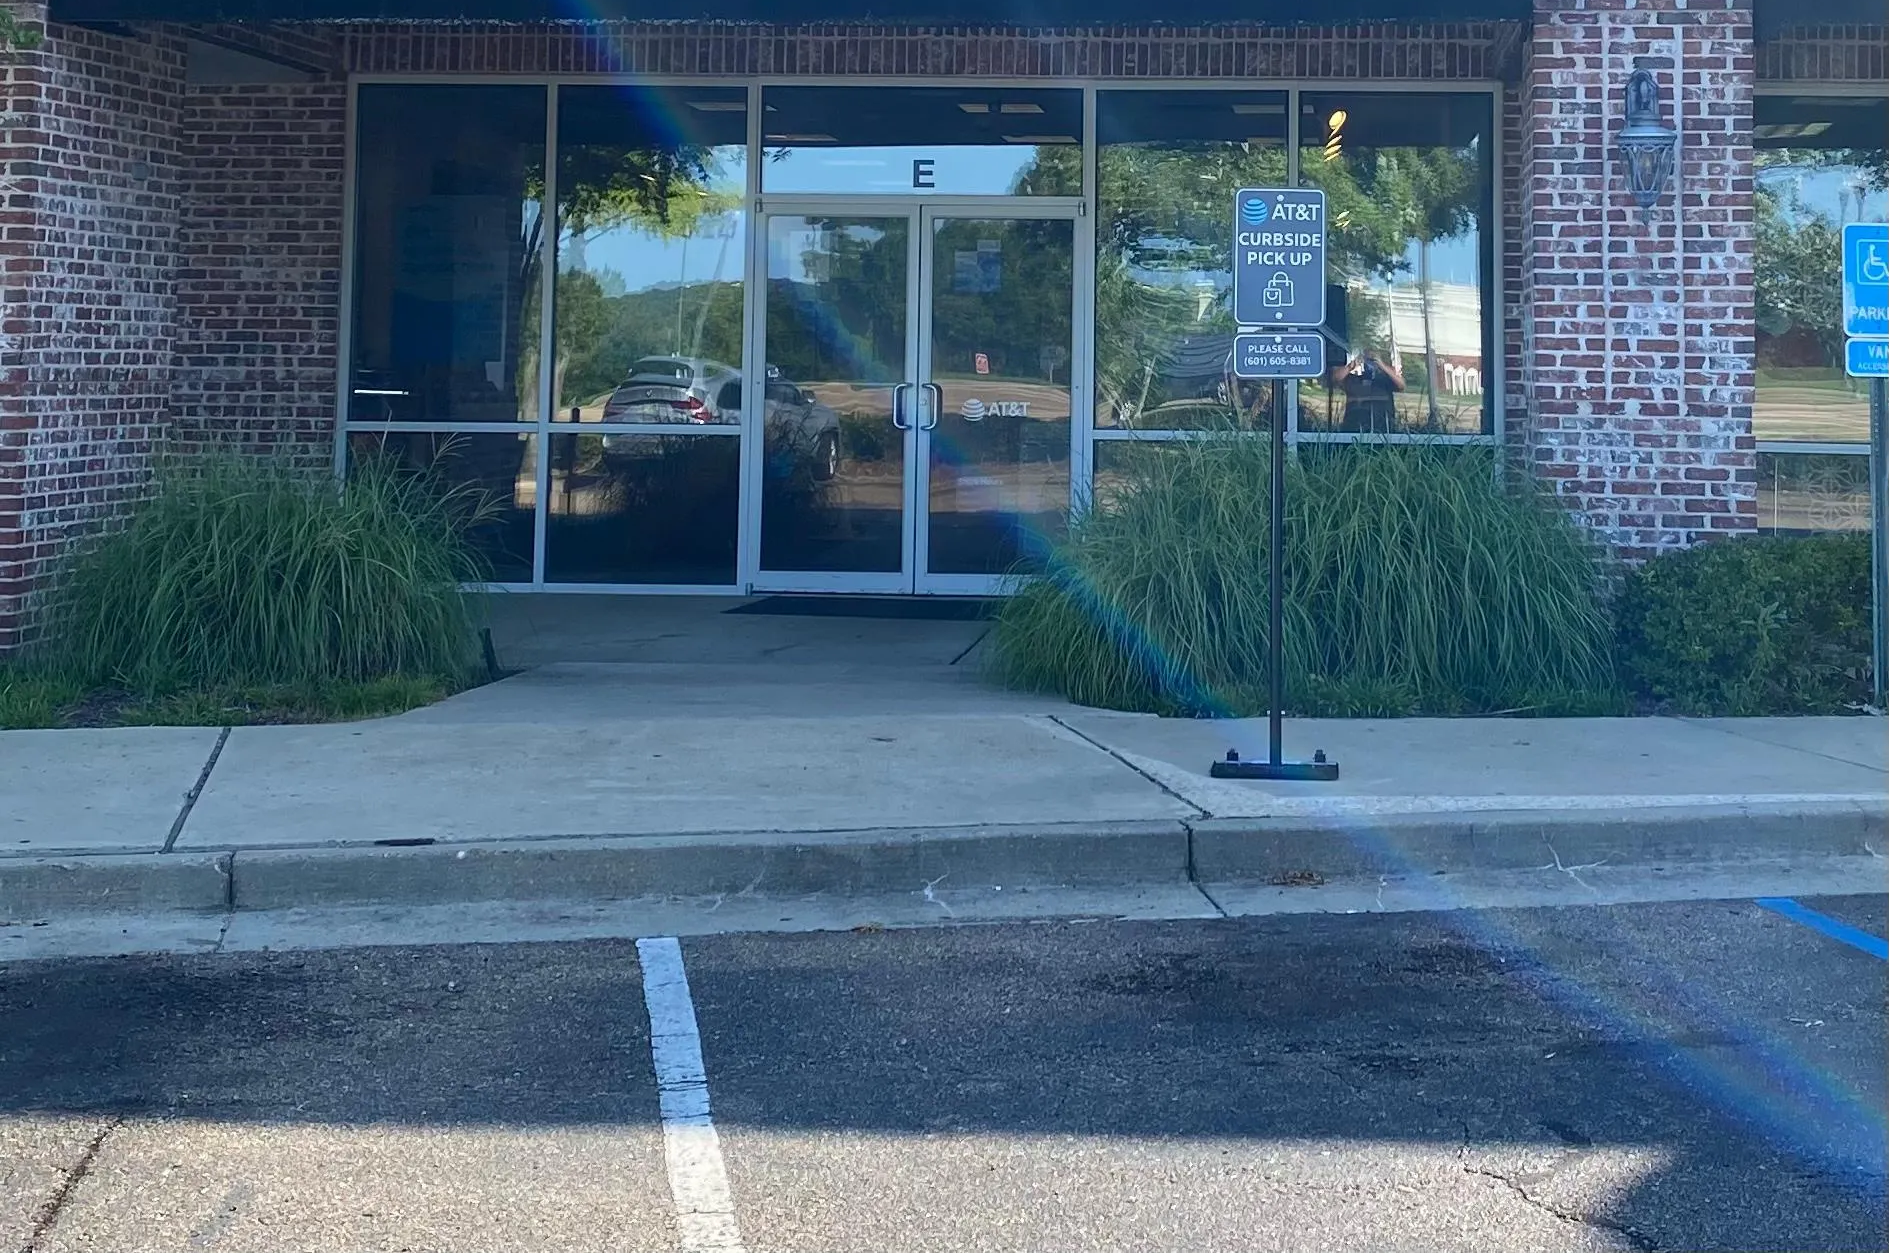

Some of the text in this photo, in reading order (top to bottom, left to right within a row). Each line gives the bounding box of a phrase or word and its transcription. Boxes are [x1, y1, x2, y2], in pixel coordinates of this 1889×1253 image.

[913, 159, 935, 188] E
[1272, 203, 1320, 221] AT&T
[1239, 232, 1321, 247] CURBSIDE
[1247, 251, 1312, 266] PICK UP
[1248, 344, 1309, 354] PLEASE CALL
[1244, 356, 1267, 367] (601)
[988, 401, 1031, 417] AT&T
